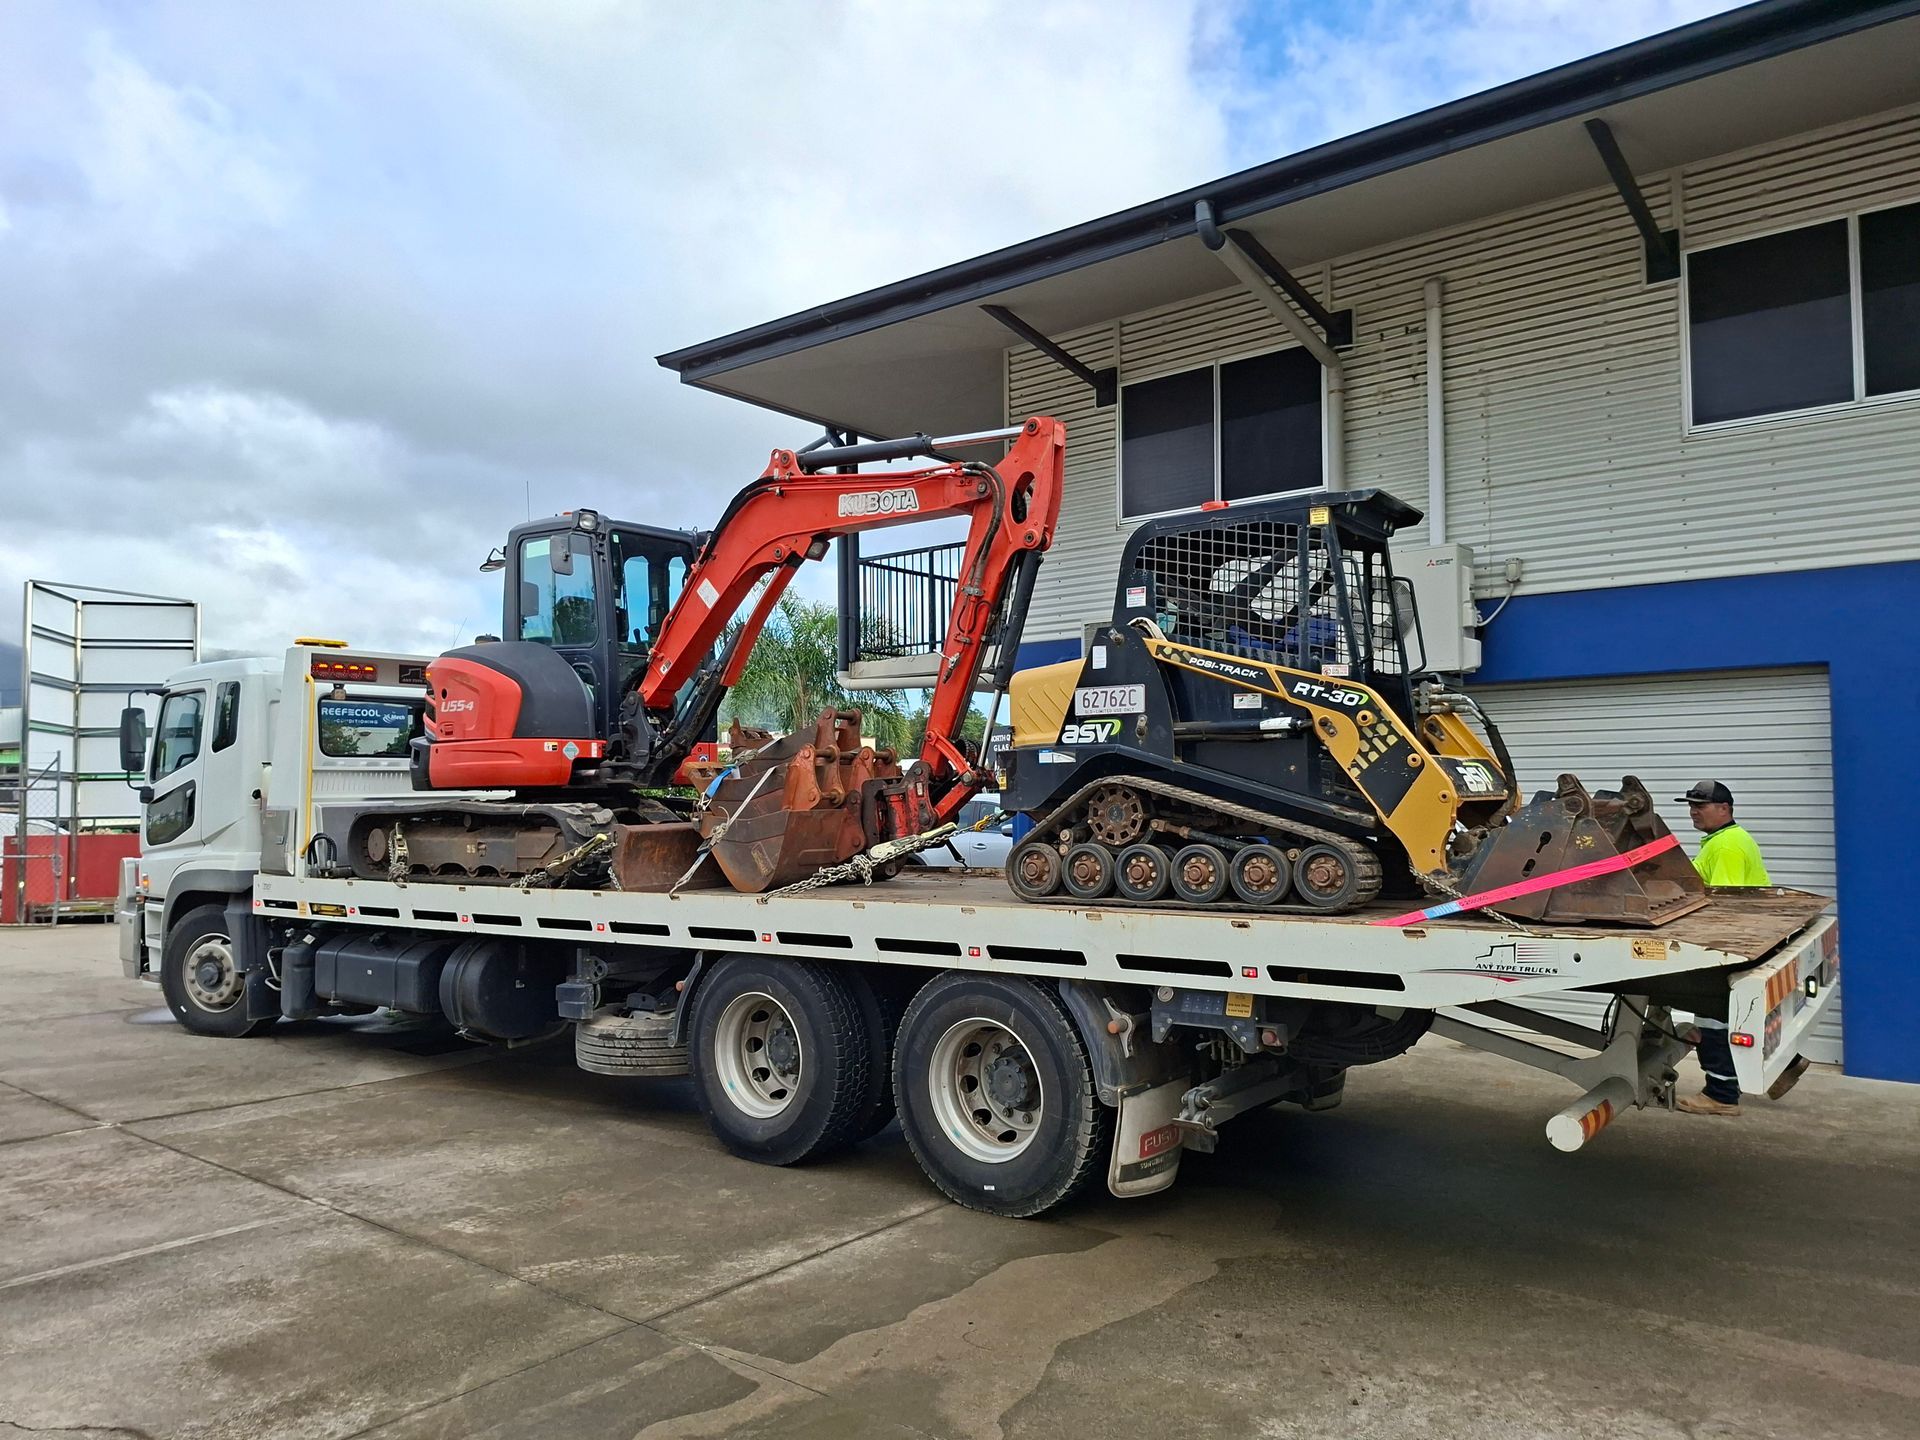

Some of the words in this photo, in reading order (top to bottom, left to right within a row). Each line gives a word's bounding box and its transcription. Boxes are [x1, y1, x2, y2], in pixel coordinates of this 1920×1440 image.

[840, 488, 918, 516] KUBOTA
[1189, 656, 1259, 679] POSI-TRACK
[1082, 689, 1137, 708] 62762C
[1292, 682, 1360, 706] RT-30
[1639, 939, 1665, 947] CAUTION
[1519, 966, 1558, 974] TRUCKS
